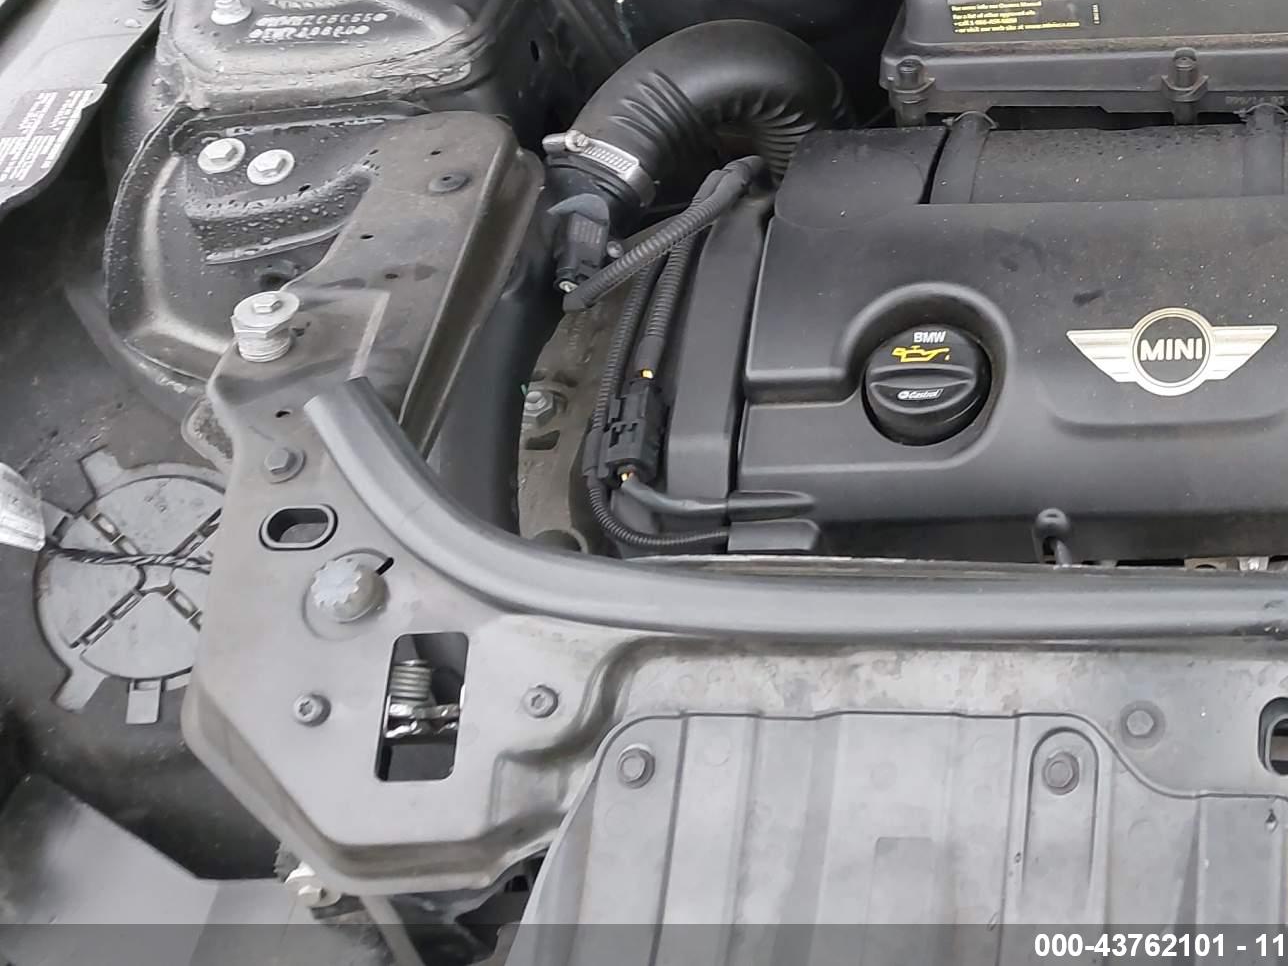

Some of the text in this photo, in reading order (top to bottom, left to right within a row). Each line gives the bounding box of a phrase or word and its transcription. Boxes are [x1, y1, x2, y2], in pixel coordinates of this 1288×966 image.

[913, 331, 946, 344] BMW
[1140, 338, 1203, 361] MINI
[908, 390, 939, 400] Castrol
